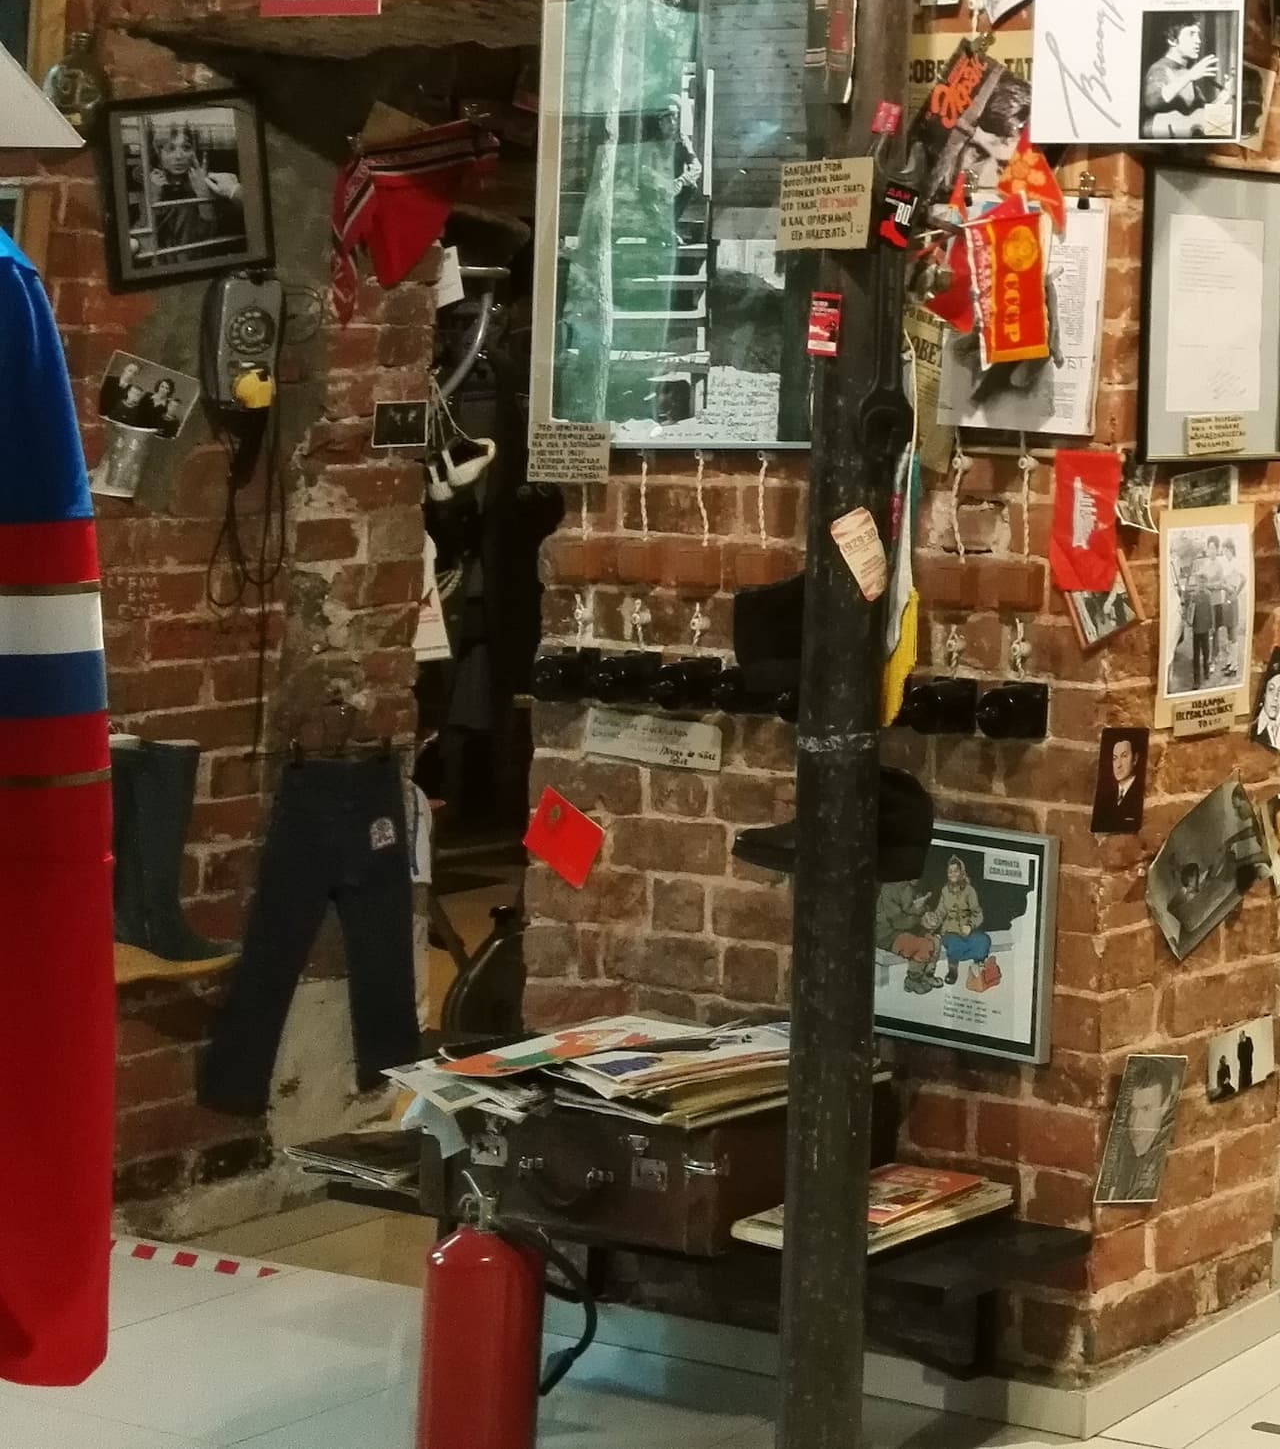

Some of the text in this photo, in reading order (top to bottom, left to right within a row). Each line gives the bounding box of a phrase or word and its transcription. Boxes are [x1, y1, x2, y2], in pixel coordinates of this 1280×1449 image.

[783, 161, 842, 177] БЛАГОДАРЯ ЭТОЙ
[816, 184, 840, 196] БУДУТ
[843, 183, 866, 193] ЗНАТЬ
[789, 215, 804, 226] КАК
[1003, 272, 1021, 344] СССР
[993, 858, 1020, 869] КОМНАТА
[989, 866, 1022, 878] СВИДАНИЙ
